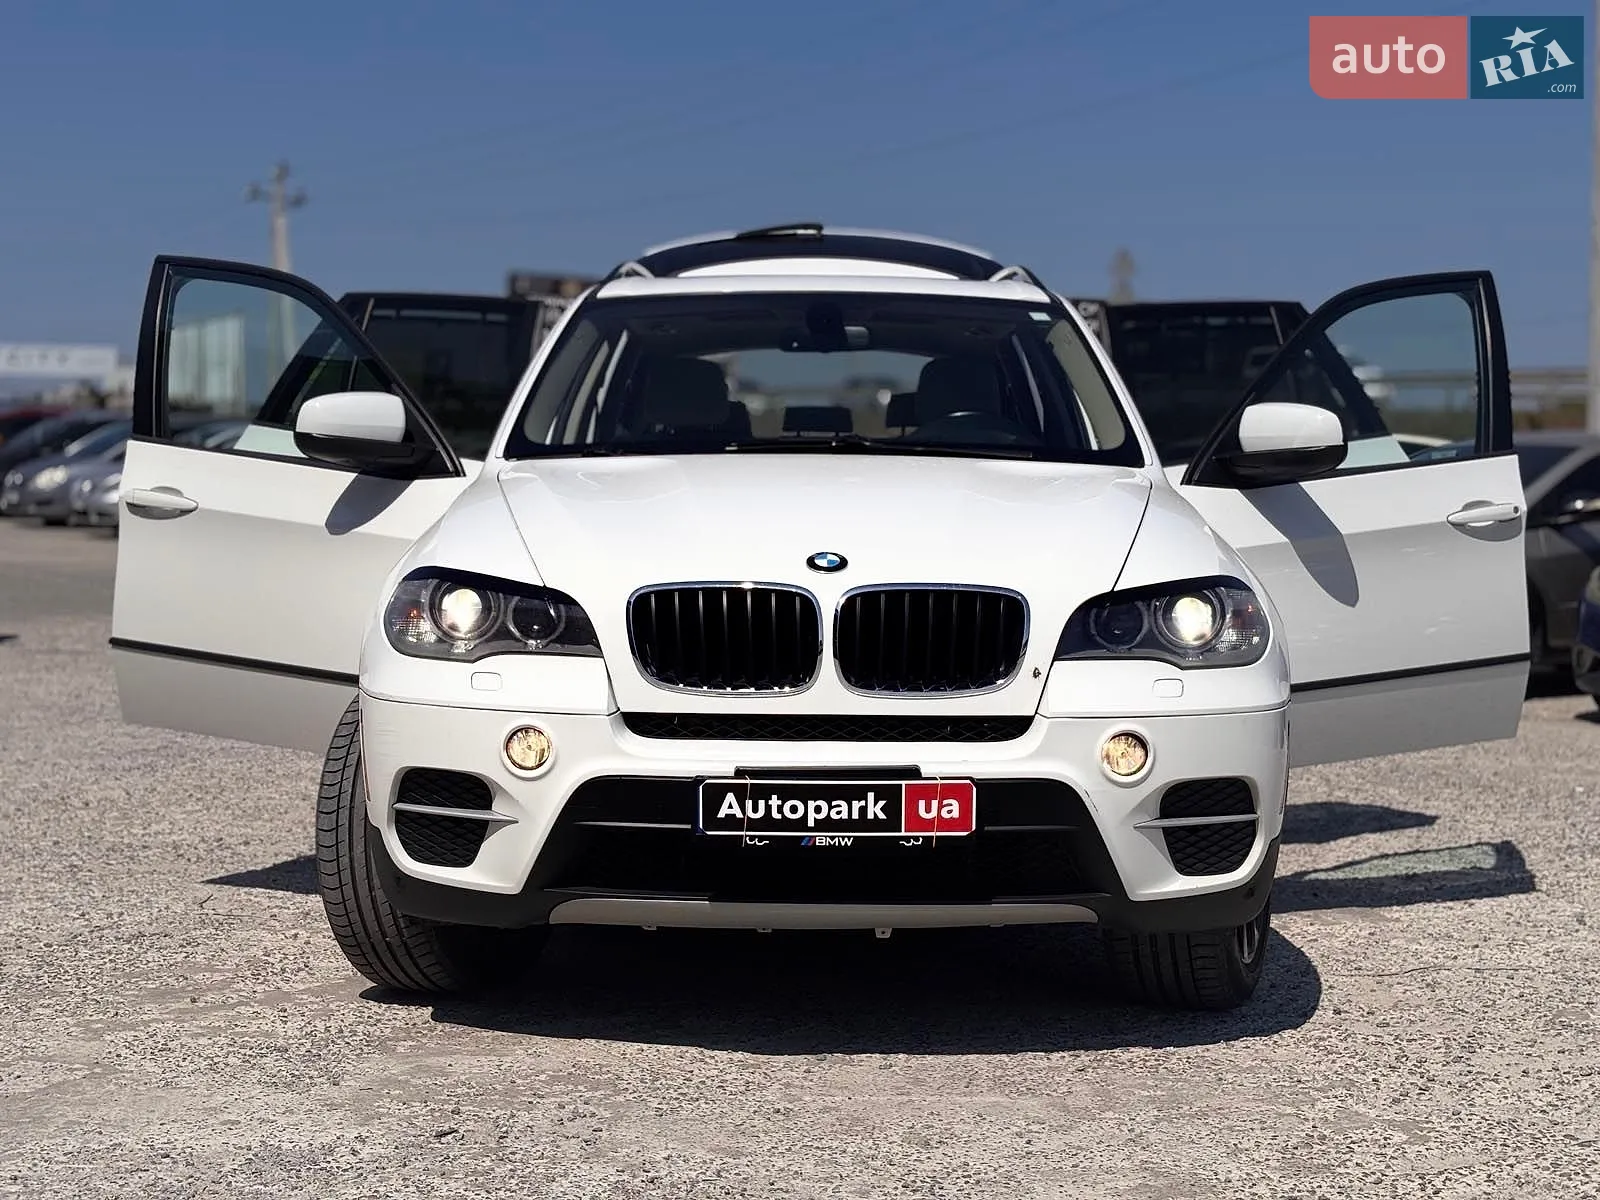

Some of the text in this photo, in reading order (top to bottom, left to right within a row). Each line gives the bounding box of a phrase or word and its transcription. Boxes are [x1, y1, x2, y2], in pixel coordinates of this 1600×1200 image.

[717, 792, 960, 827] Autopark ua
[815, 836, 854, 847] BMW
